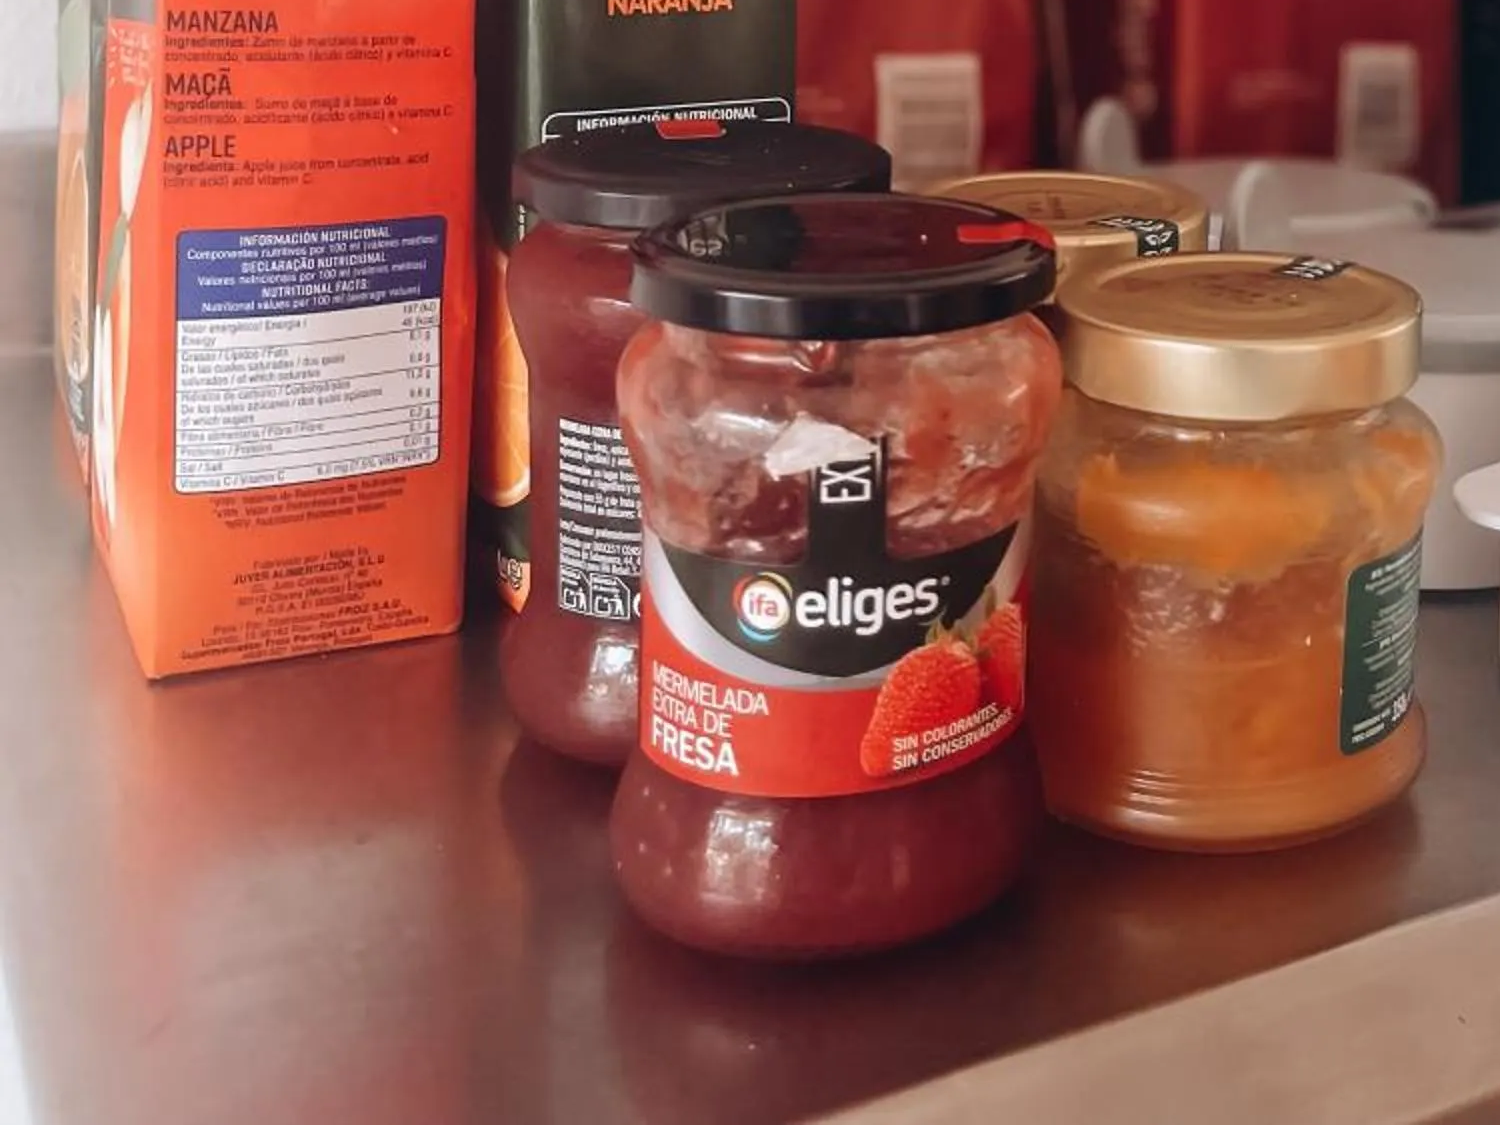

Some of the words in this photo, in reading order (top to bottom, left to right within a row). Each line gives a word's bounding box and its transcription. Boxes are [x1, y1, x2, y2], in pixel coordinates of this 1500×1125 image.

[165, 10, 279, 33] MANZANA
[165, 67, 232, 99] MAÇÃ
[164, 134, 236, 158] APPLE
[239, 231, 319, 248] INFORMACIÓN
[321, 227, 391, 242] NUTRICIONAL
[748, 592, 780, 619] ifa
[795, 577, 940, 636] eliges
[652, 659, 769, 716] MERMELADA
[652, 685, 698, 729] EXTRA
[703, 708, 733, 738] DE
[651, 713, 739, 777] FRESA
[893, 732, 918, 752] SIN
[892, 752, 918, 771] SIN
